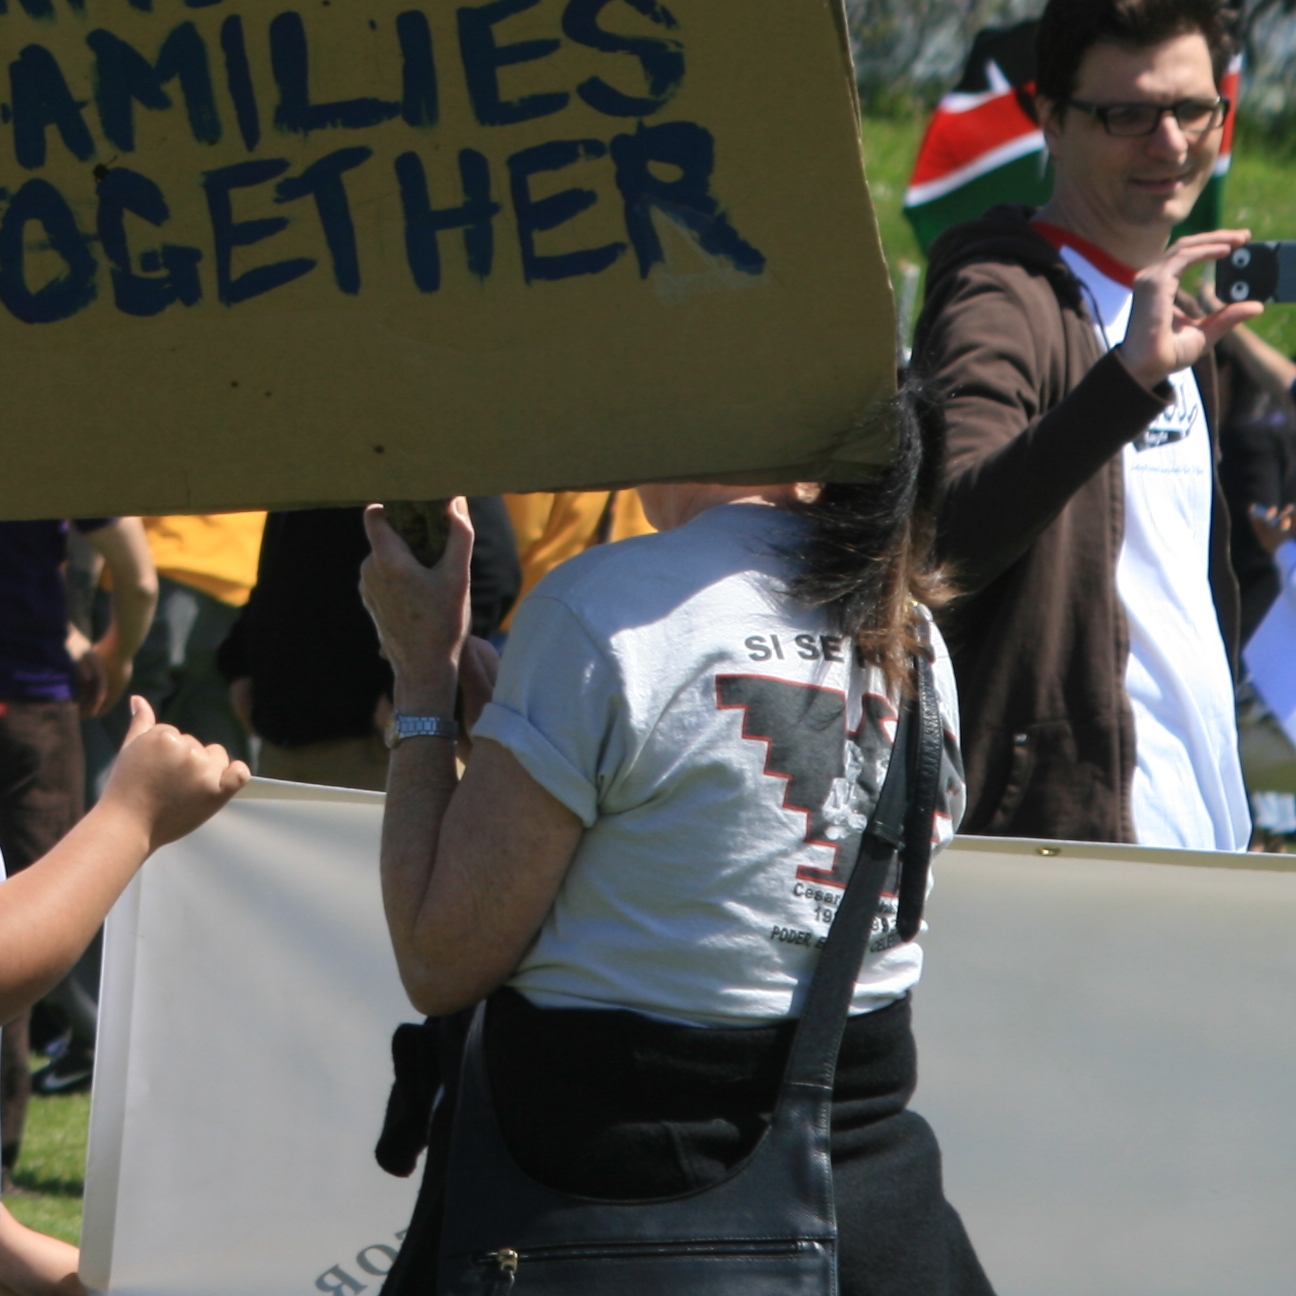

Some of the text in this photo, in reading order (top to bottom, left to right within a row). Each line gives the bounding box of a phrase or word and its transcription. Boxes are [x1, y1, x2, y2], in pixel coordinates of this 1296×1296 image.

[744, 634, 785, 662] SI
[794, 633, 845, 663] SE
[793, 882, 841, 905] Cesar
[770, 925, 811, 946] PODER
